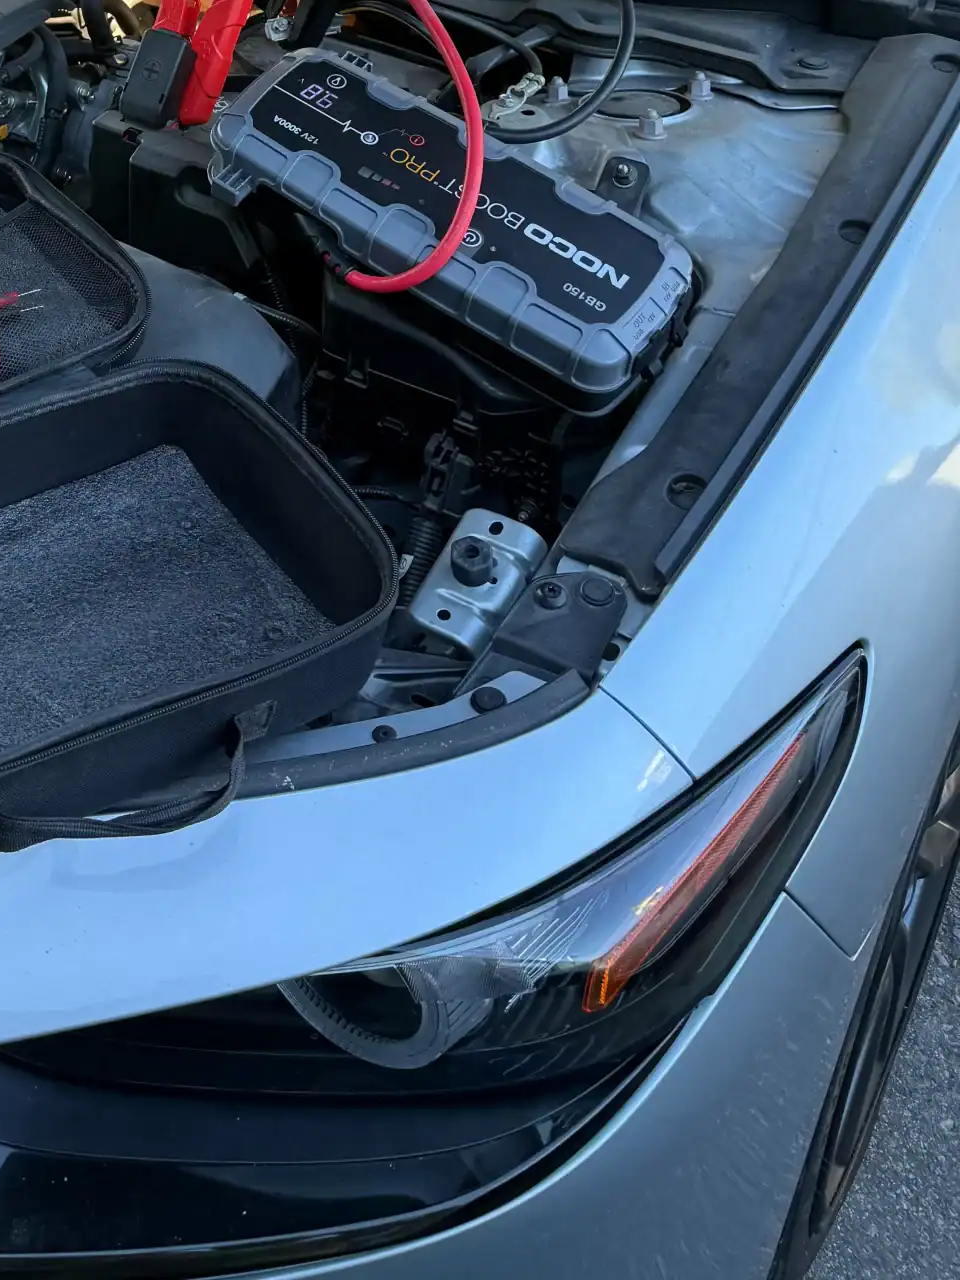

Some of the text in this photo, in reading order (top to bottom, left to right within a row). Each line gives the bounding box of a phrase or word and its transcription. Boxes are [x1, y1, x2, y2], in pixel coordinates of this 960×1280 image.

[273, 114, 320, 145] 12V 3000A
[523, 222, 630, 290] NOCO
[563, 282, 607, 312] GB150
[633, 312, 646, 328] OUT
